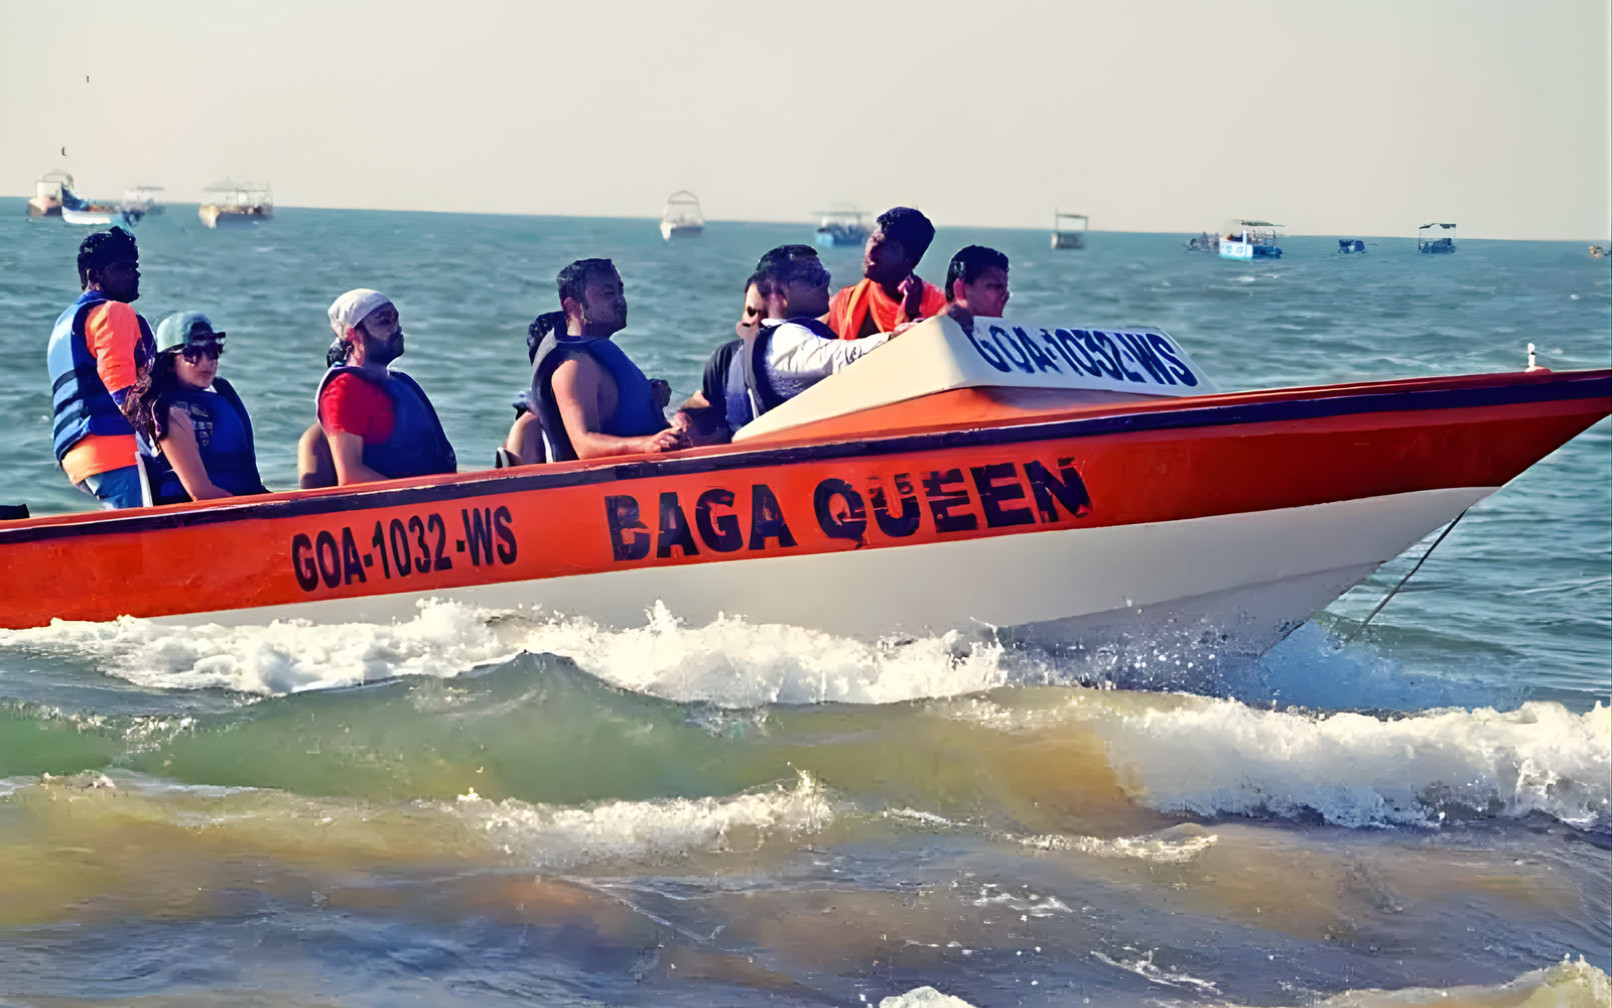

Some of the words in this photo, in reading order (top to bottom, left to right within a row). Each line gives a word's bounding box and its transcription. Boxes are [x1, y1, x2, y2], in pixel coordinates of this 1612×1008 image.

[291, 505, 517, 592] GOA-1032-WS
[603, 483, 798, 562] BAGA
[813, 456, 1095, 549] QUEEN
